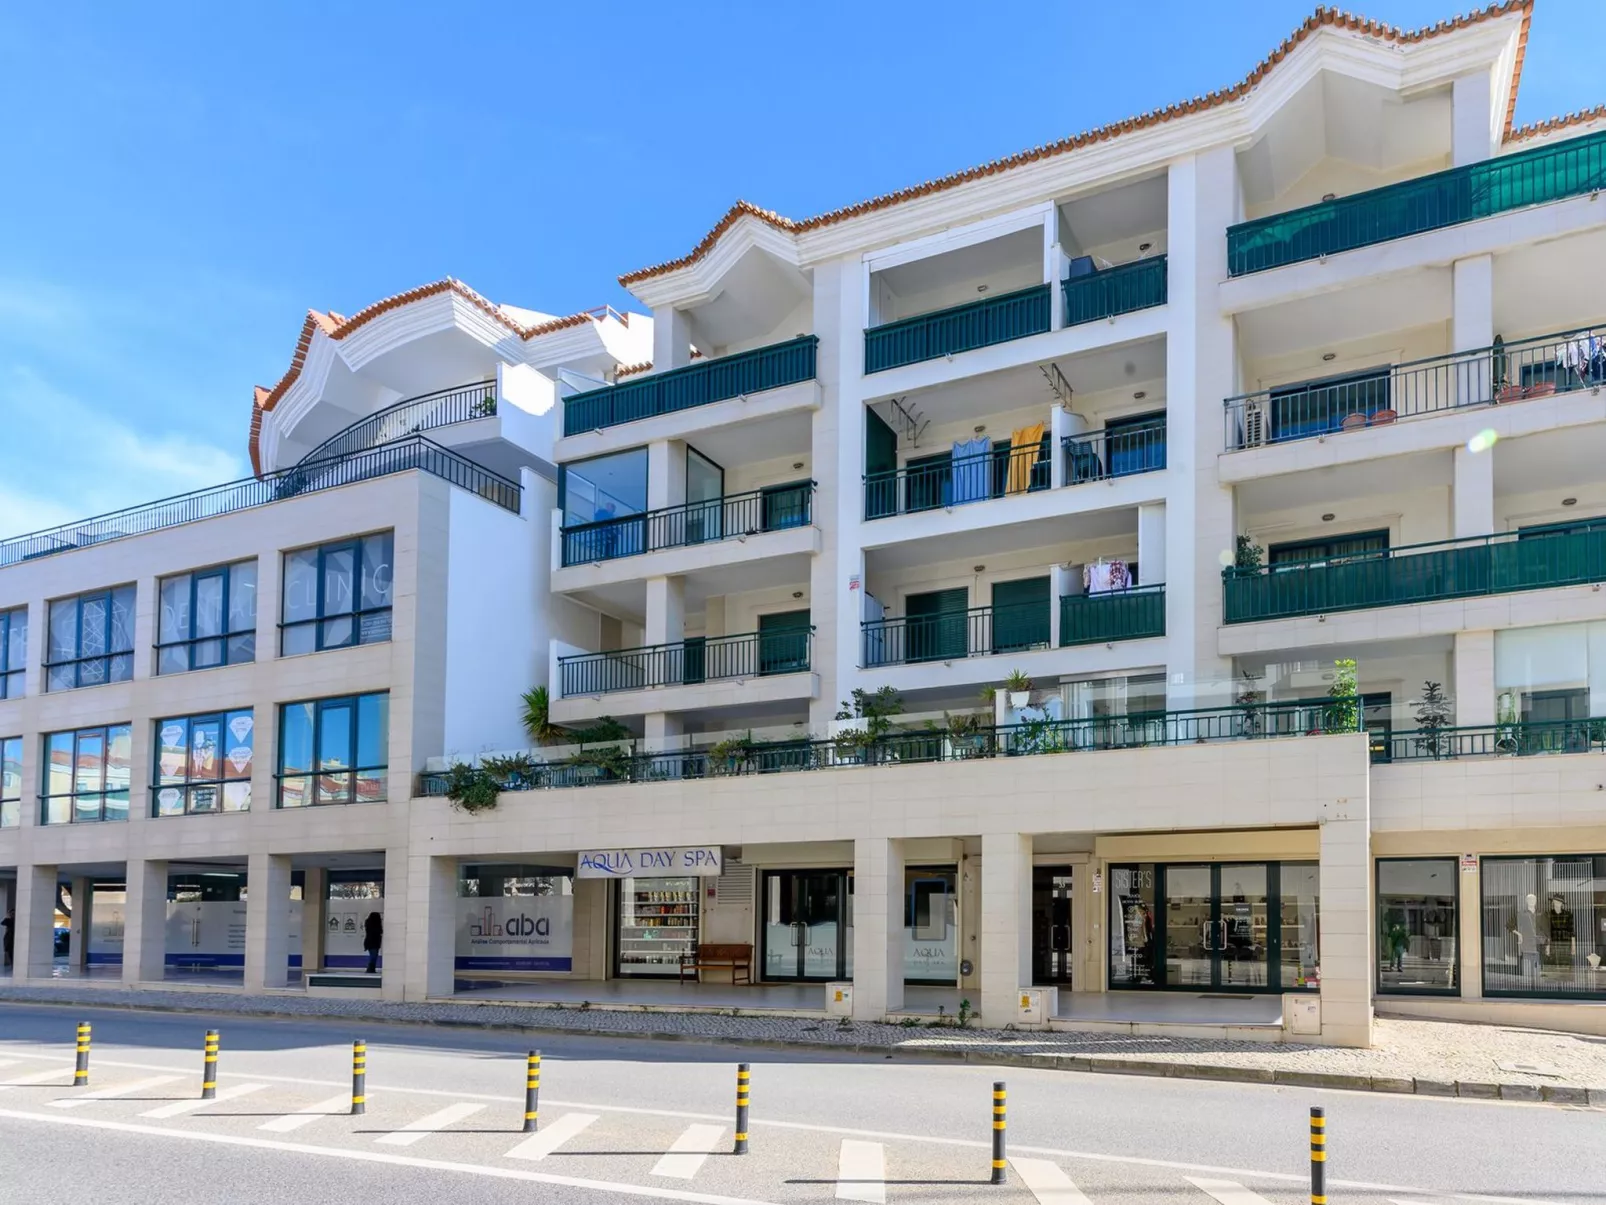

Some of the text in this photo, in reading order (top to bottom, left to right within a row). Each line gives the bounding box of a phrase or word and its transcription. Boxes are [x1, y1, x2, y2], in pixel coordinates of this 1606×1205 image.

[163, 590, 257, 632] DENTAL
[287, 564, 389, 609] CLINIC
[580, 850, 718, 873] AQUA DAY SPA
[1115, 870, 1152, 889] SISTER'S
[506, 913, 549, 936] aba
[913, 947, 945, 957] AQUA
